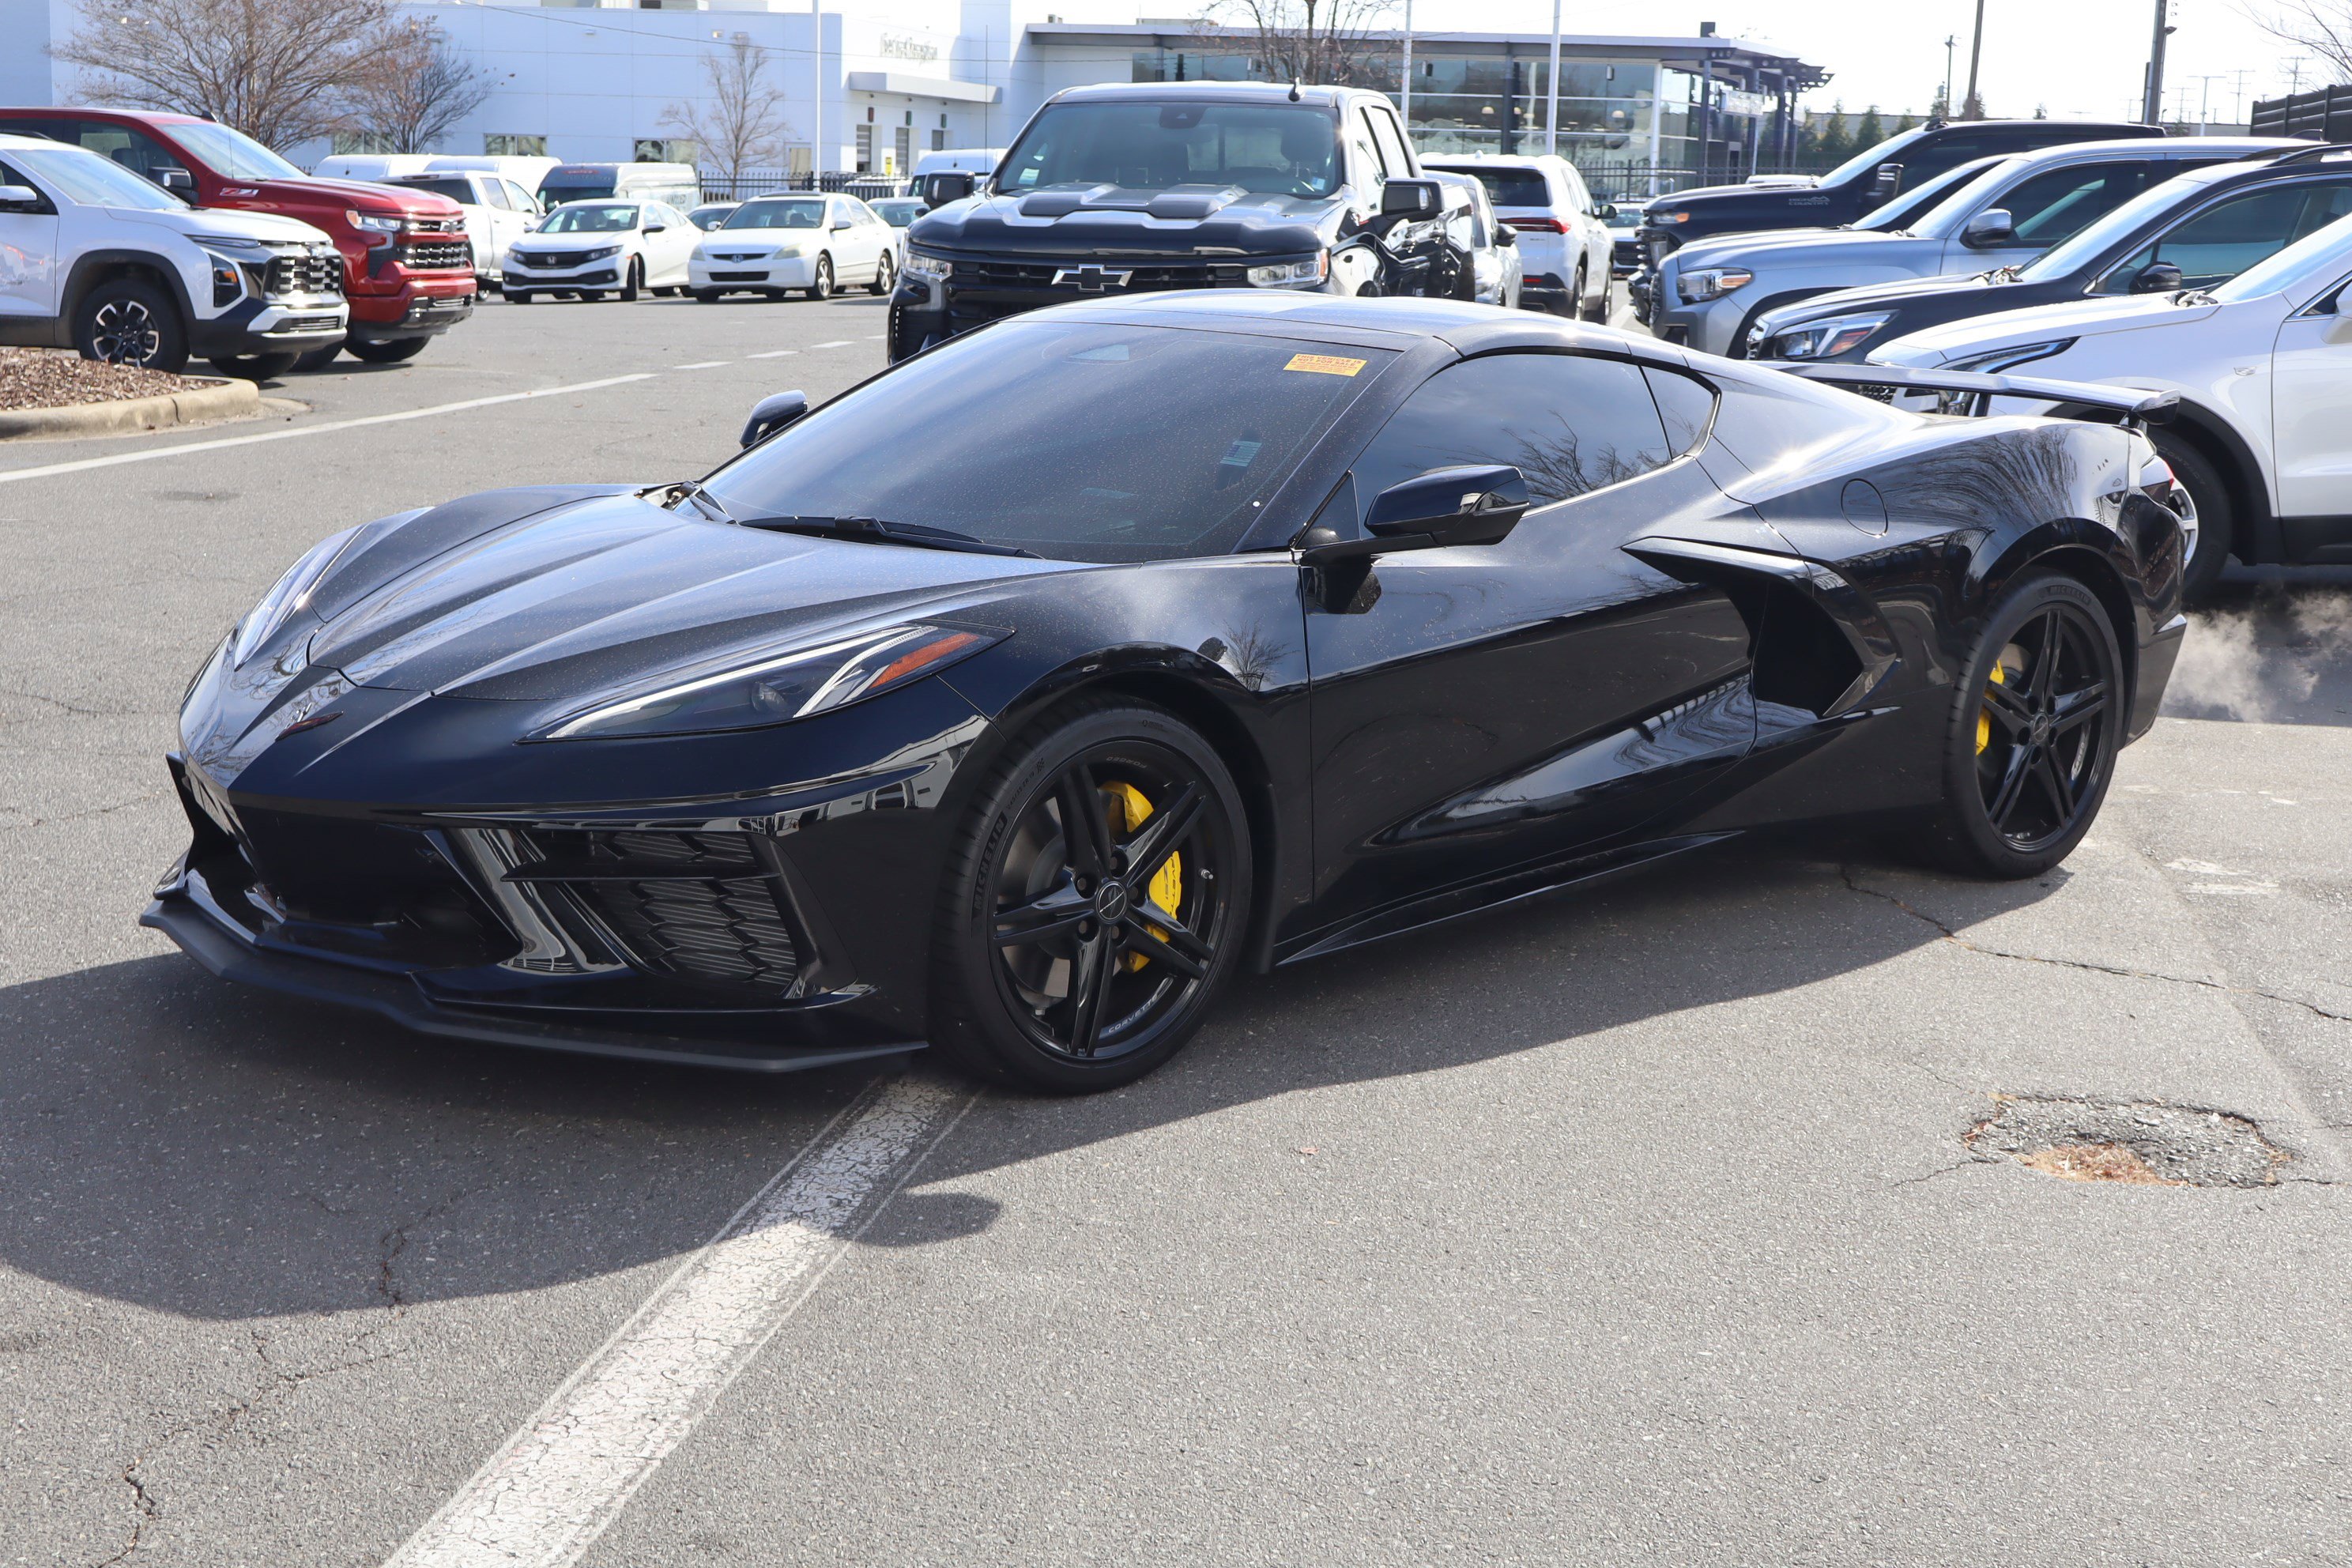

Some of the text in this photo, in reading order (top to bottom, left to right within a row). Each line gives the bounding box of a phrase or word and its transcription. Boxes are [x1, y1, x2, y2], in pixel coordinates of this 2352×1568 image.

[1106, 756, 1148, 769] FORGED
[974, 816, 1006, 910] MICHELIN
[1108, 993, 1158, 1033] CORVETTE
